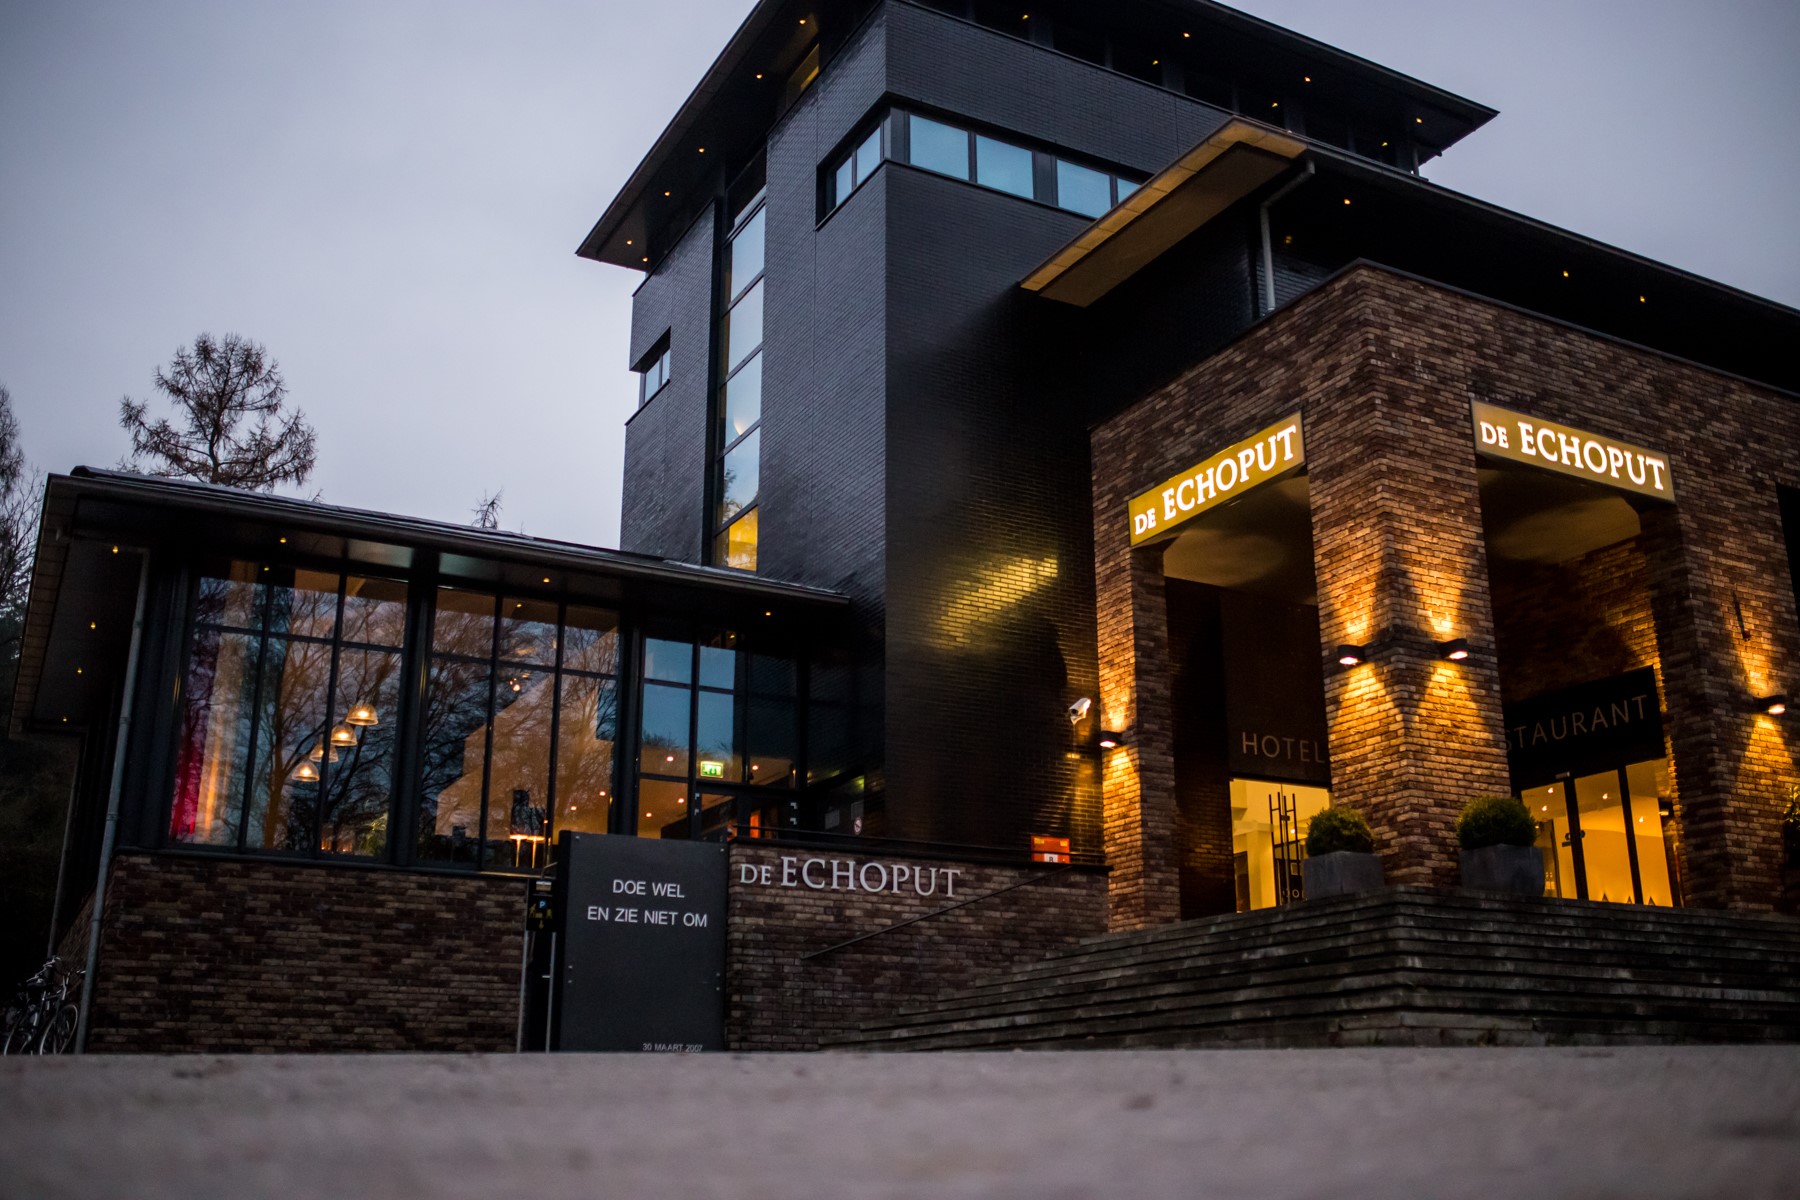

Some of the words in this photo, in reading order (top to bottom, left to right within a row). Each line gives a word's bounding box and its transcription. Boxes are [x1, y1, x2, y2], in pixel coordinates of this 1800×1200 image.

[1480, 421, 1509, 449] DE
[1517, 421, 1665, 491] ECHOPUT
[1134, 507, 1156, 535] DE
[1162, 424, 1296, 521] ECHOPUT
[1242, 731, 1325, 764] HOTEL
[612, 879, 646, 895] DOE
[652, 882, 685, 898] WEL
[739, 863, 771, 886] DE
[780, 856, 961, 898] ECHOPUT
[587, 906, 609, 921] EN
[614, 908, 638, 923] ZIE
[644, 910, 678, 925] NIET
[683, 912, 707, 927] OM
[642, 1042, 652, 1051] 30
[654, 1043, 684, 1052] MAART
[685, 1044, 703, 1053] 2007
